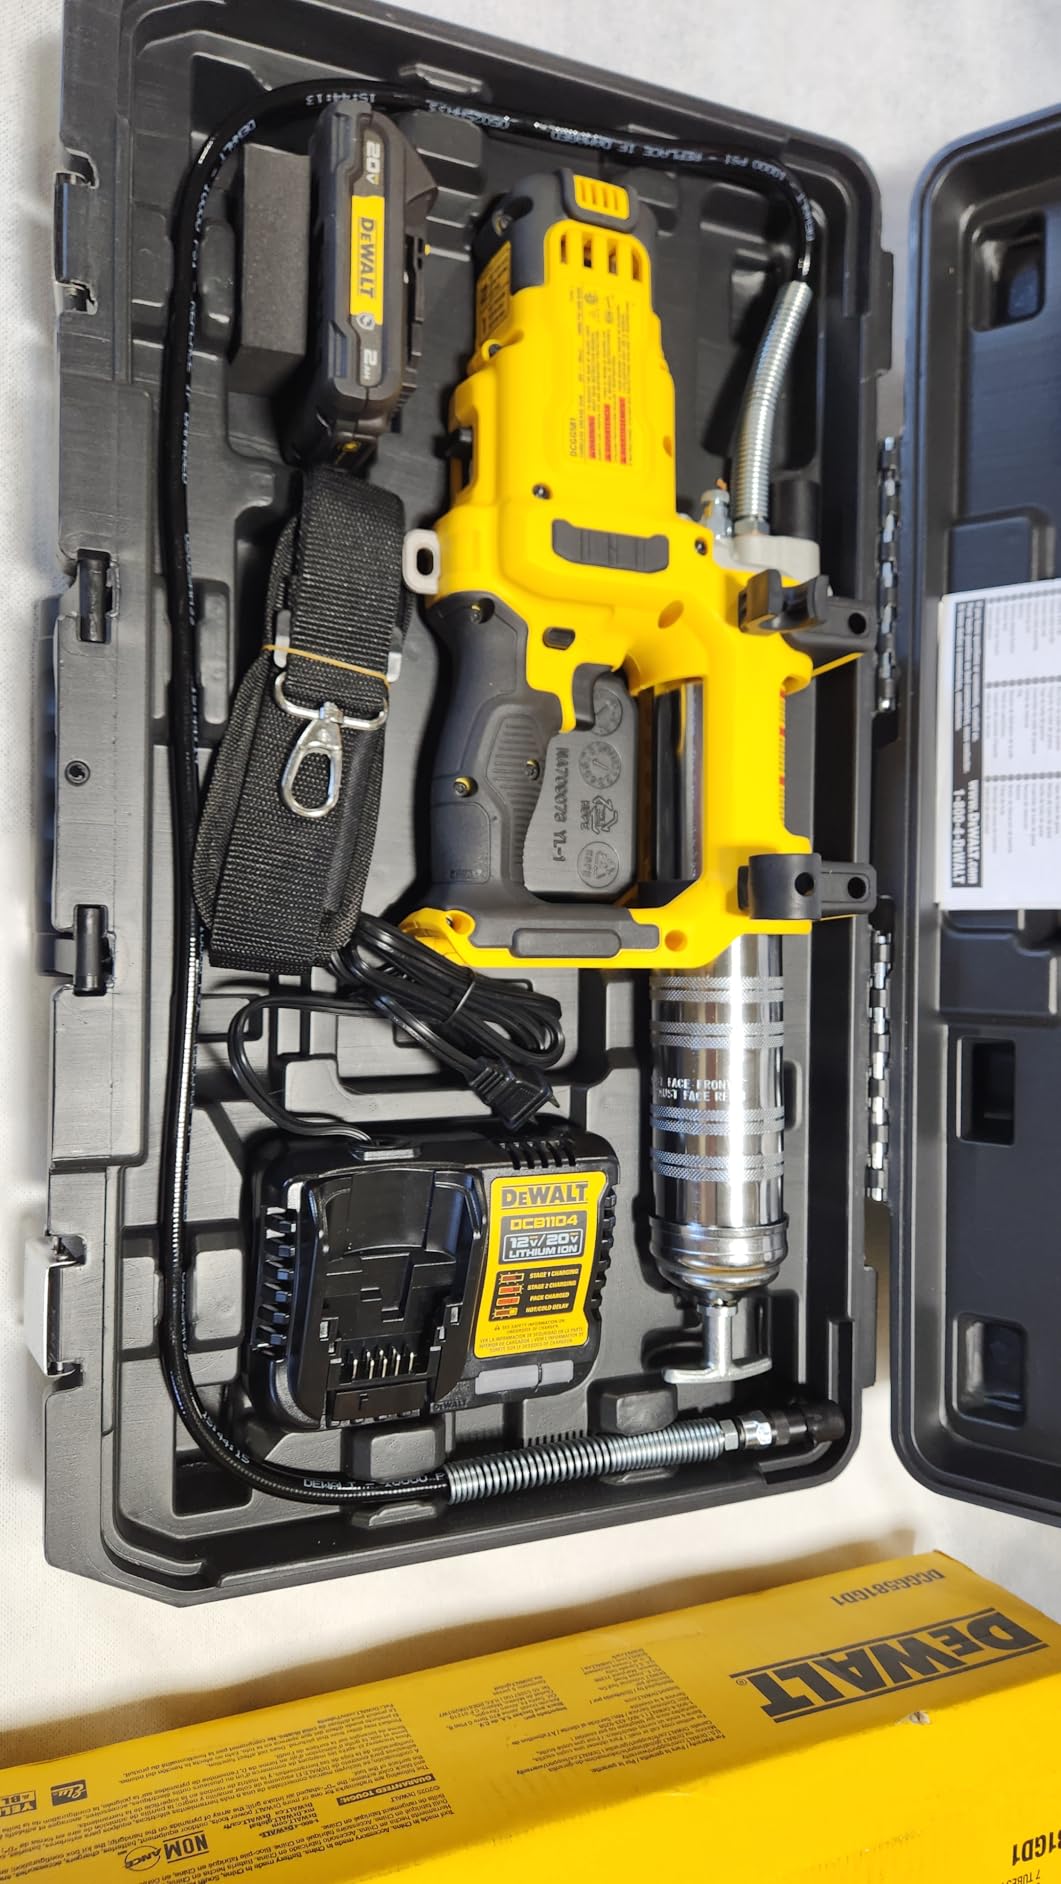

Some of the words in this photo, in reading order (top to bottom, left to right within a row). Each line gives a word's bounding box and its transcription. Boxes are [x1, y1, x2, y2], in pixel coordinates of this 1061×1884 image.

[642, 145, 702, 162] REPLACE
[359, 217, 375, 298] DEWALT
[668, 1077, 690, 1089] FACE
[697, 1080, 733, 1090] FRON
[683, 1090, 710, 1101] FACE
[501, 1183, 588, 1208] DEWALT
[510, 1216, 578, 1231] DCB1104
[509, 1247, 557, 1258] LITHIUM
[557, 1244, 577, 1255] ION
[551, 1269, 579, 1277] CHARGING
[548, 1280, 576, 1289] CHARGING
[545, 1292, 569, 1301] CHARGED
[526, 1304, 552, 1313] HOT/COLD
[829, 1567, 945, 1607] DCGG581GD1
[745, 1610, 1042, 1718] DEWALT
[374, 1774, 432, 1793] GUARANTEED
[163, 1833, 208, 1859] NOM
